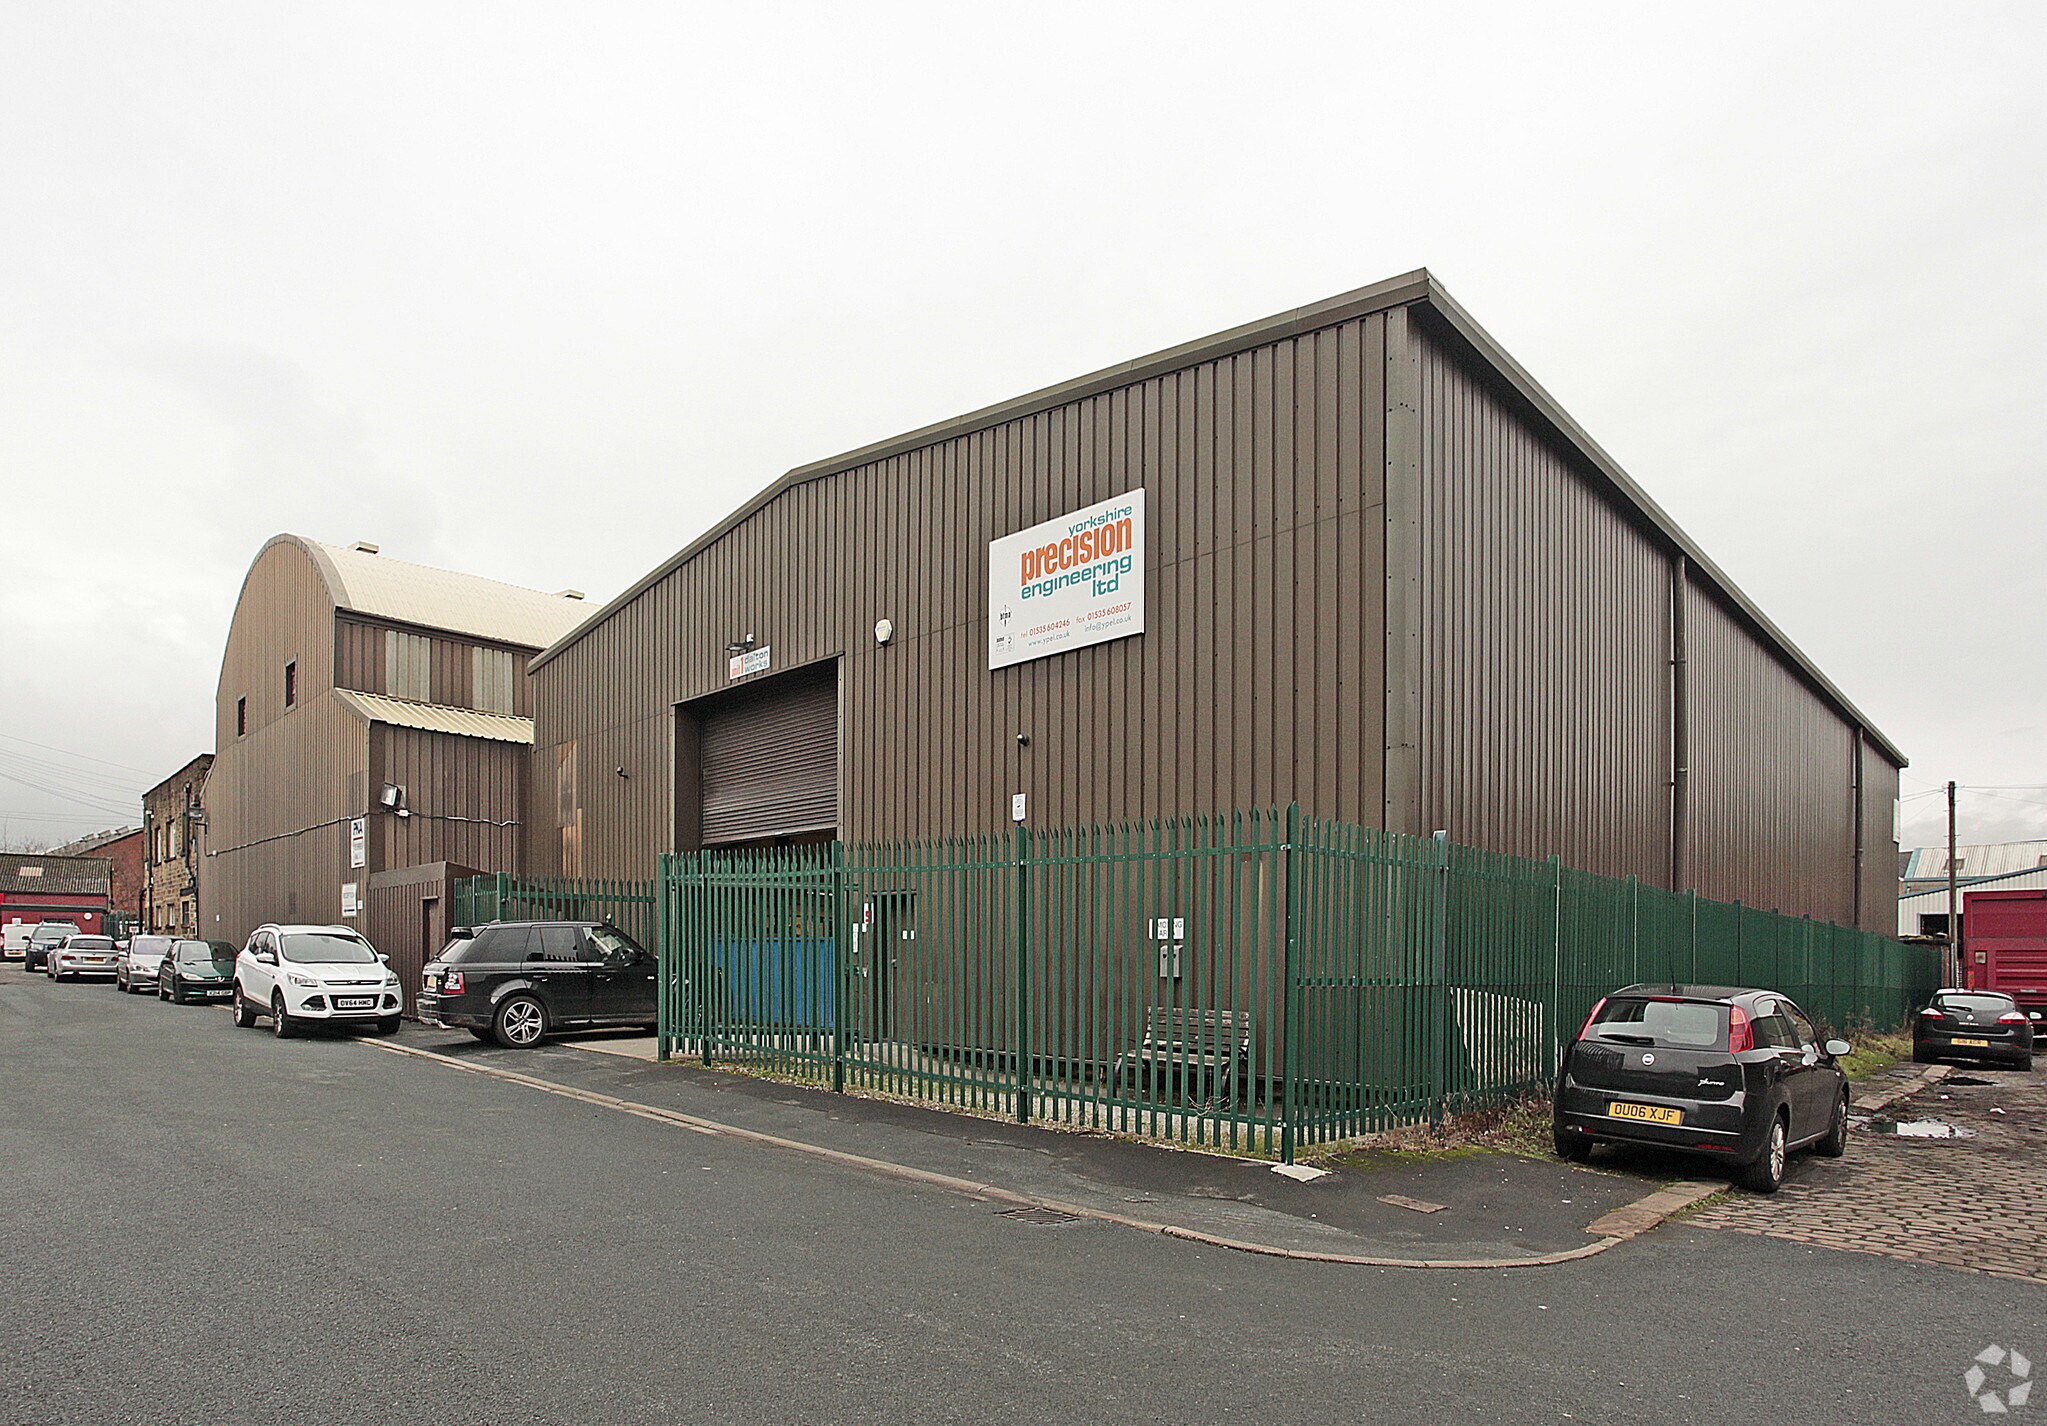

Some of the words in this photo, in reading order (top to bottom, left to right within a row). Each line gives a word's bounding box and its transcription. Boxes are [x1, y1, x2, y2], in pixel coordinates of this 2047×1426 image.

[1068, 505, 1132, 537] yorkshire
[1021, 517, 1132, 586] precision
[1021, 554, 1132, 600] engineering
[1092, 573, 1119, 597] ltd
[744, 650, 769, 664] dalton
[744, 660, 768, 672] works
[1614, 1103, 1646, 1118] OU06
[1649, 1108, 1675, 1121] XJF
